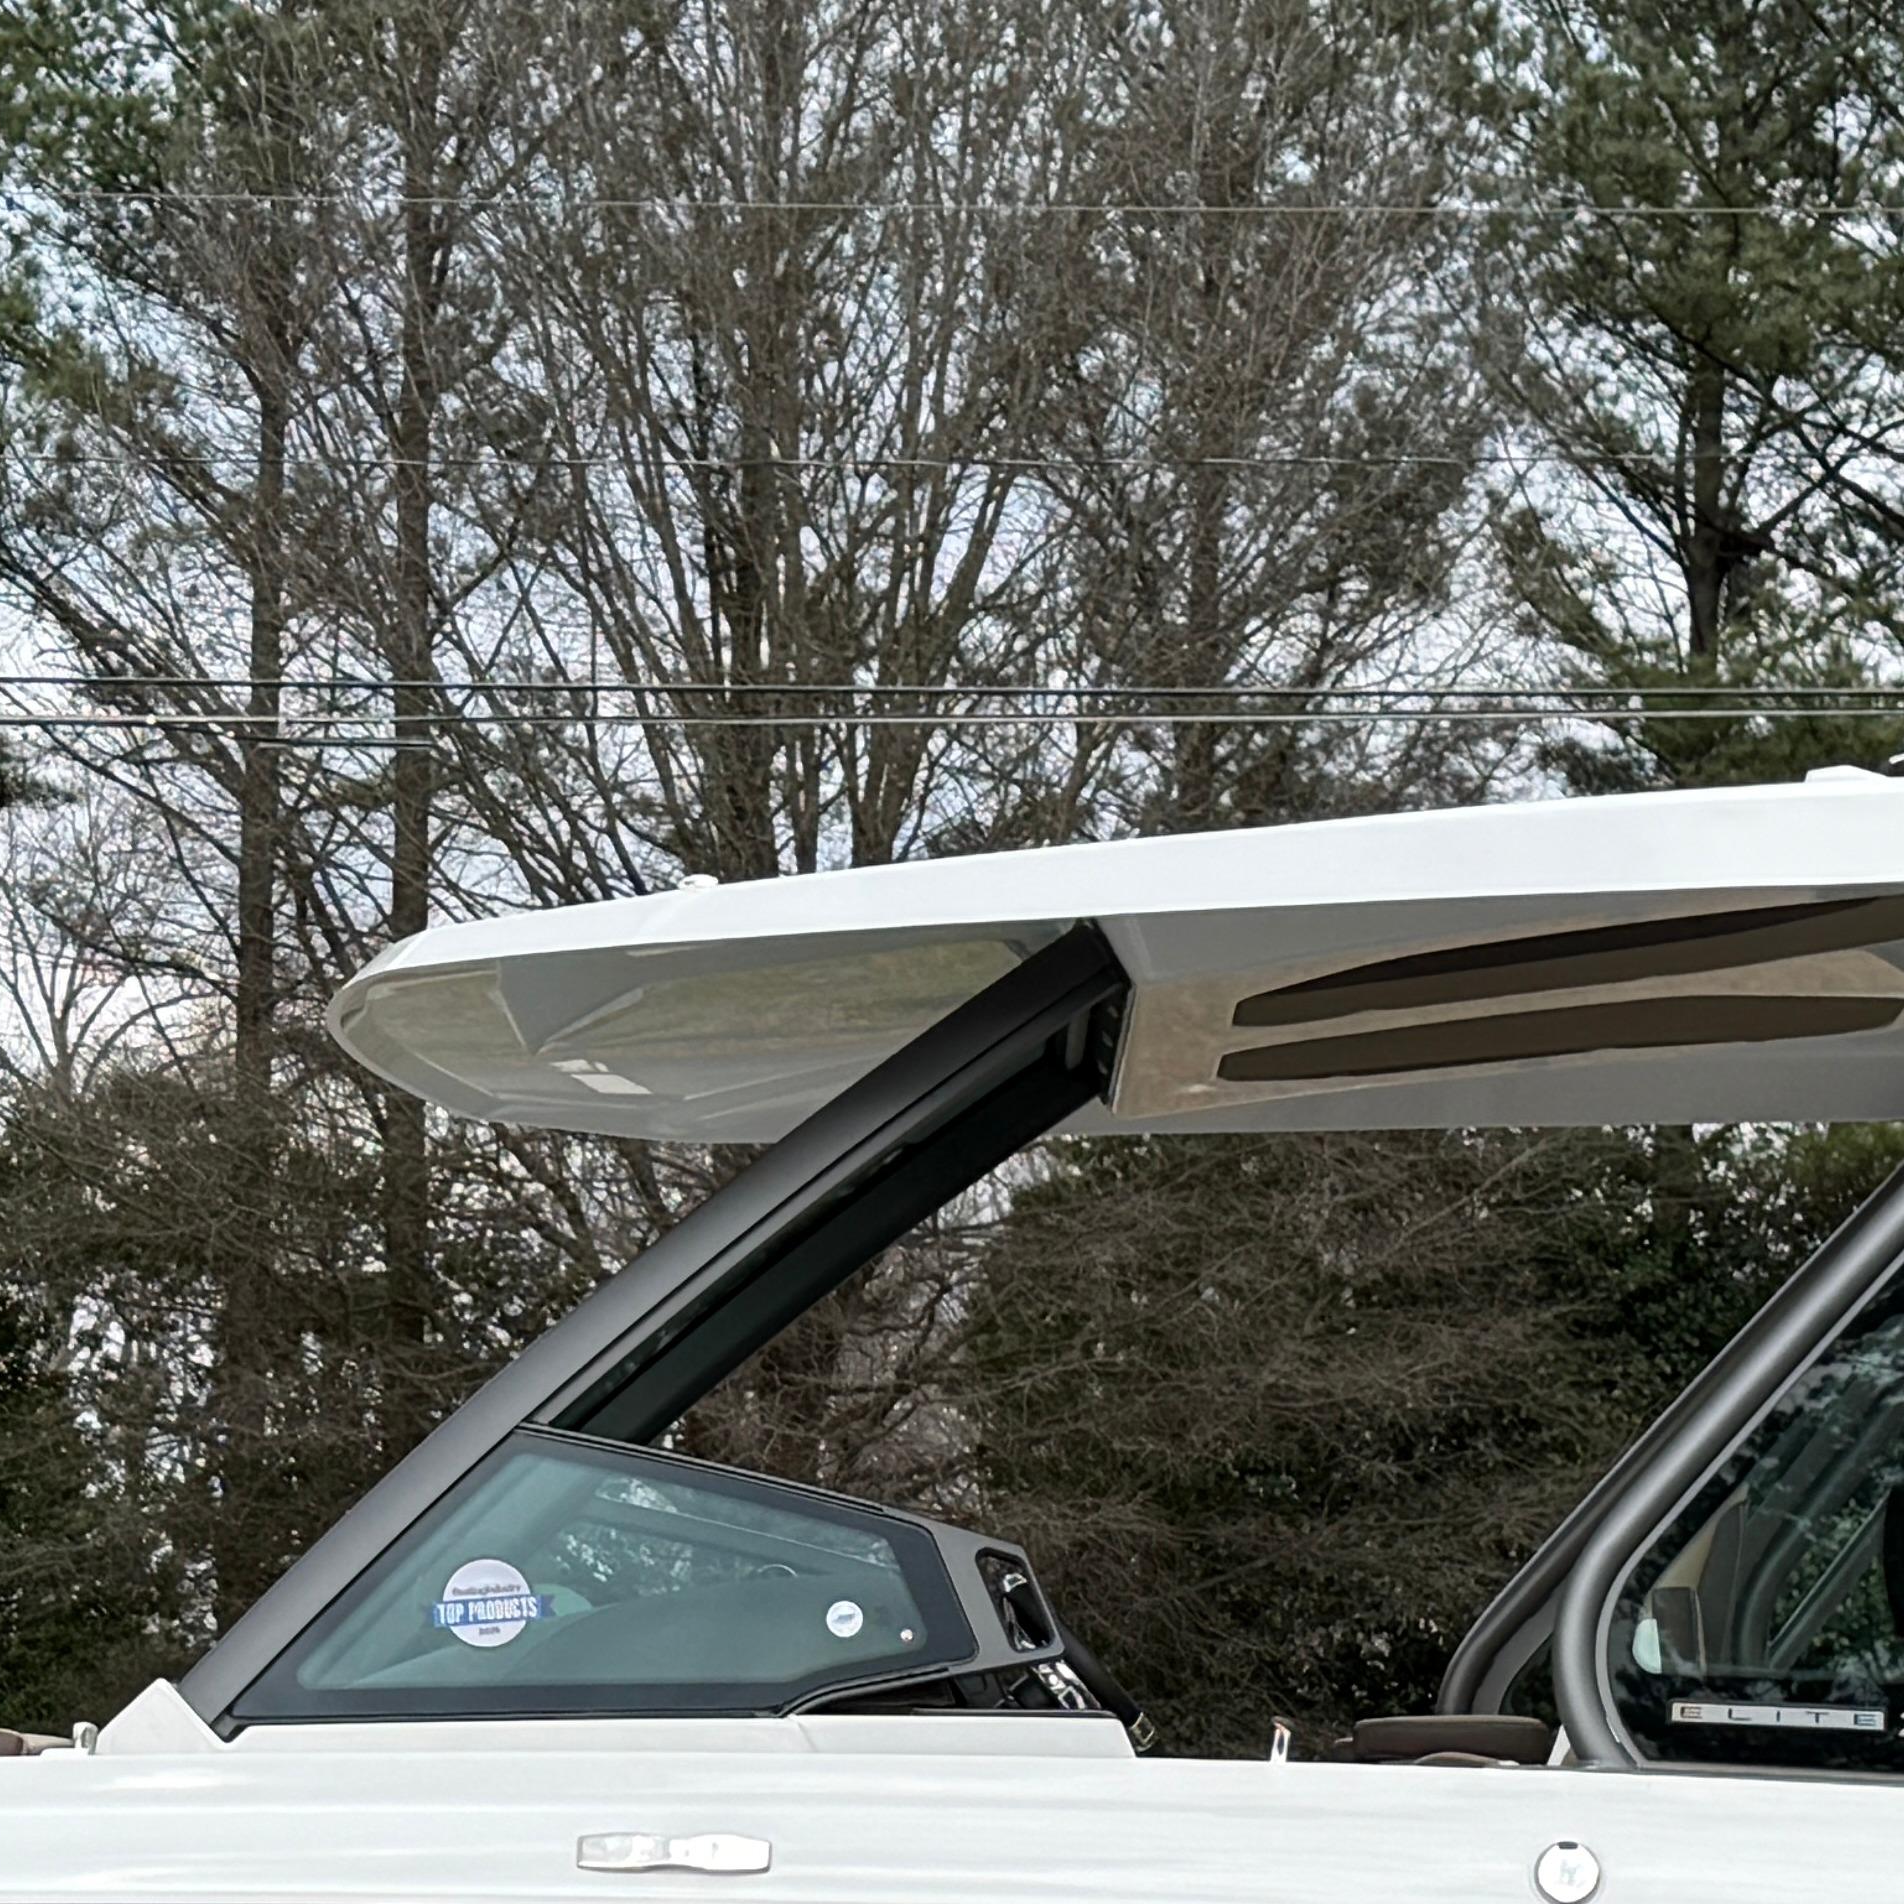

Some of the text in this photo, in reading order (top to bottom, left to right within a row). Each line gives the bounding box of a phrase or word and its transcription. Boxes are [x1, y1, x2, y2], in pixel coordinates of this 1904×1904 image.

[437, 1596, 537, 1625] TOP PRODUCTS
[1679, 1705, 1878, 1727] ELITE
